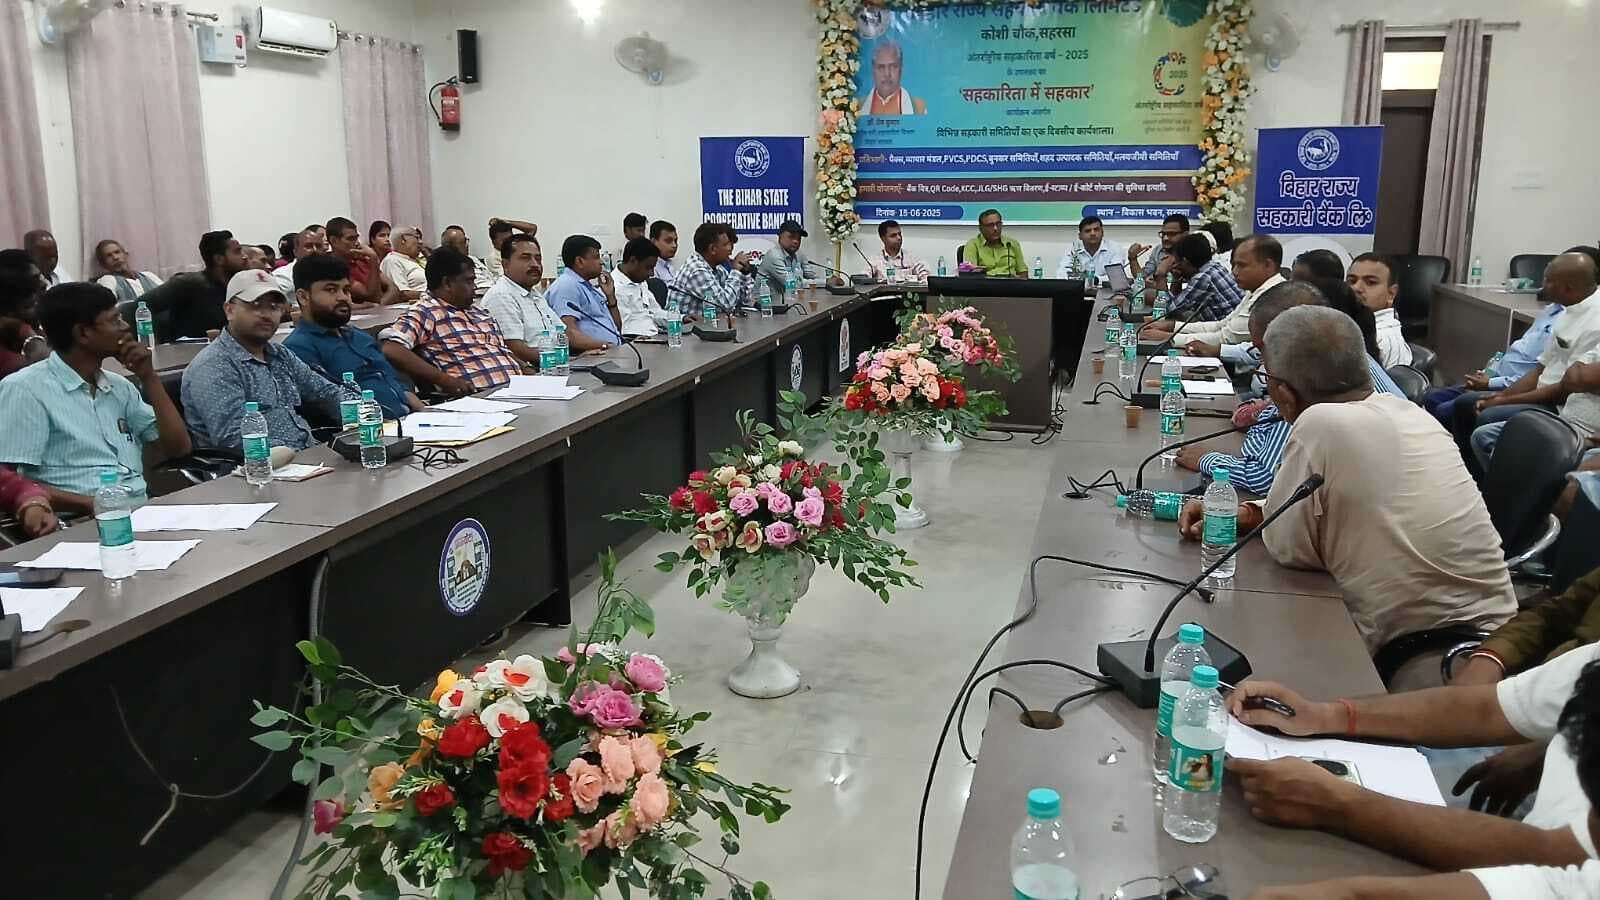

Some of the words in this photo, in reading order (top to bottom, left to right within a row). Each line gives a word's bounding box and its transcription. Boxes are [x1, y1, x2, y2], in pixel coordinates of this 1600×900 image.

[981, 24, 1009, 41] कोशी
[1004, 50, 1042, 62] सहकारिता
[1065, 49, 1089, 60] 2025
[1030, 82, 1042, 100] में
[960, 126, 988, 138] सहकारी
[1021, 127, 1031, 136] का
[1033, 127, 1046, 138] एक
[1047, 125, 1075, 136] दिवसीय
[1280, 170, 1321, 199] बिहार
[1321, 177, 1360, 197] राज्य
[718, 188, 734, 206] THE
[735, 188, 762, 206] BIHAR
[764, 188, 789, 206] STATE
[1096, 208, 1114, 217] स्थान
[1121, 206, 1145, 217] विकास
[1257, 199, 1315, 229] सहकारी
[1317, 199, 1347, 227] बैंक
[762, 213, 786, 230] BANK
